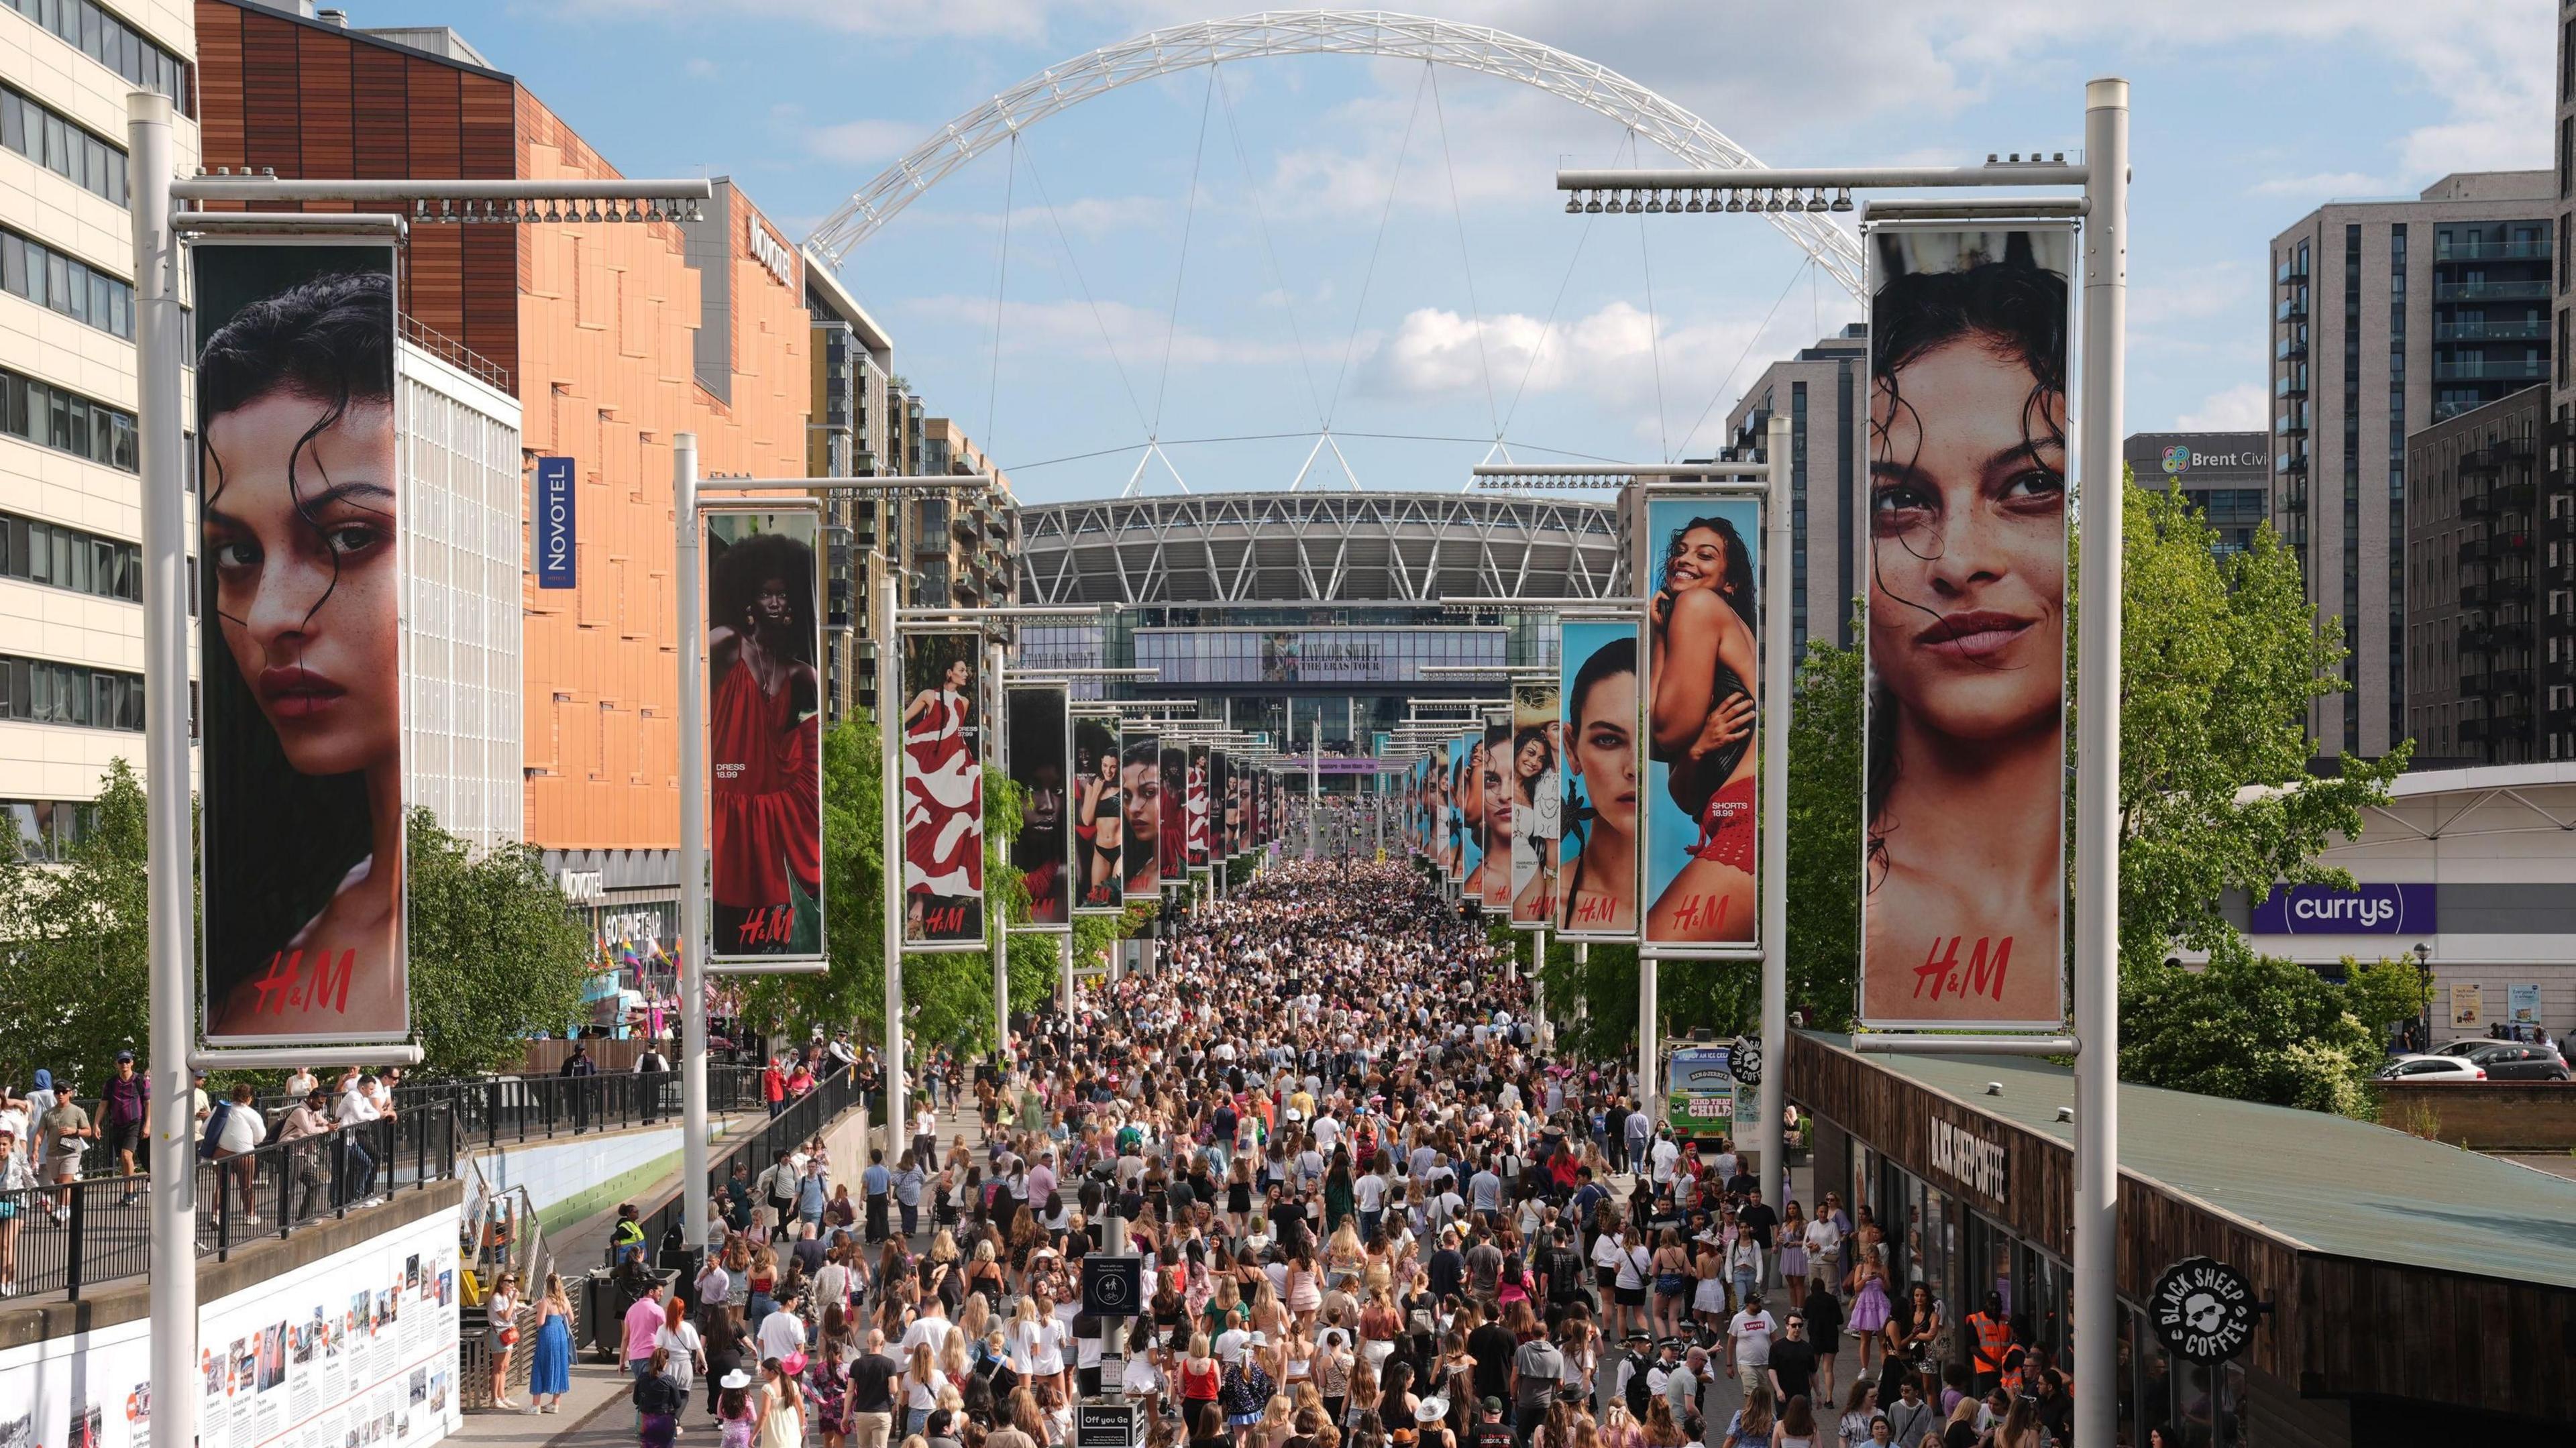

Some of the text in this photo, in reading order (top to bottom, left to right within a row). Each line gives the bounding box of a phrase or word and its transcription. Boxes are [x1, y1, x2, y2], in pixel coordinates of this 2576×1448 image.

[750, 213, 794, 289] NOVOTEL
[2192, 452, 2269, 466] Brent Civi
[547, 465, 566, 570] NOVOTEL
[1027, 653, 1095, 669] TAYLOR SWIFT
[1300, 644, 1379, 661] TAYLOR SWIFT
[1300, 663, 1379, 671] THE ERAS TOUR
[561, 868, 606, 900] NOVOTEL
[926, 907, 965, 934] H&M
[1527, 896, 1556, 915] H&M
[1578, 897, 1617, 924] H&M
[1673, 895, 1729, 932] H&M
[739, 907, 795, 945] H&M
[254, 948, 356, 1015] H&M
[1913, 936, 2013, 1002] H&M
[1688, 1105, 1731, 1117] CHILD
[1931, 1116, 2004, 1204] BLACK SHEEP COFFEE
[2160, 1268, 2244, 1325] BLACK SHEEP
[2186, 1319, 2247, 1357] COFFEE
